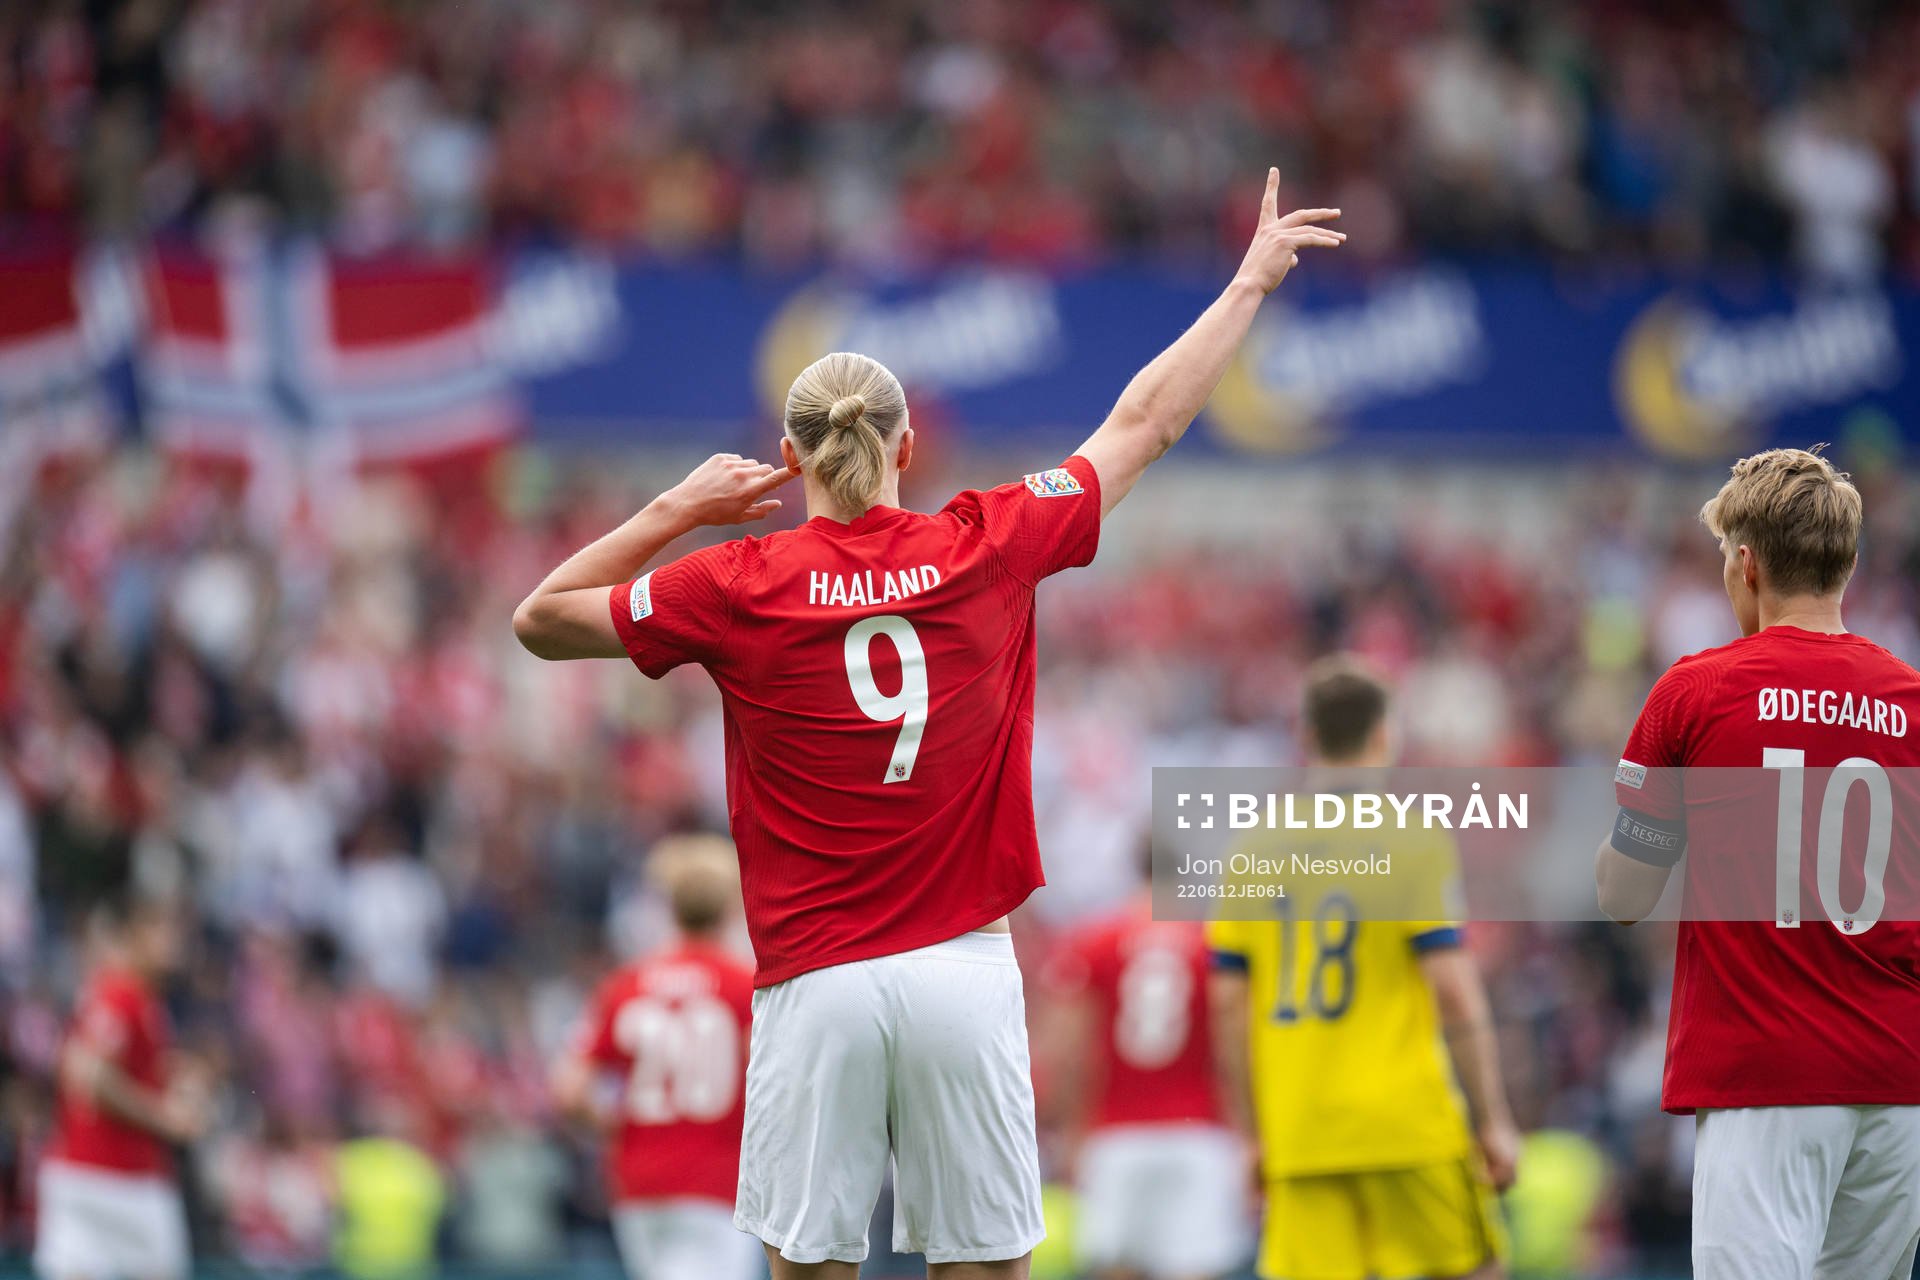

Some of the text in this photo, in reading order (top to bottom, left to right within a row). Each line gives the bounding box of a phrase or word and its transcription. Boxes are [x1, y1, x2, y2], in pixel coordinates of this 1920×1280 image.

[809, 565, 941, 606] HAALAND
[844, 615, 928, 784] 9
[1758, 687, 1907, 738] ØDEGAARD
[1631, 825, 1680, 847] RESPECT
[1762, 747, 1893, 935] 10
[1271, 887, 1358, 1022] 18
